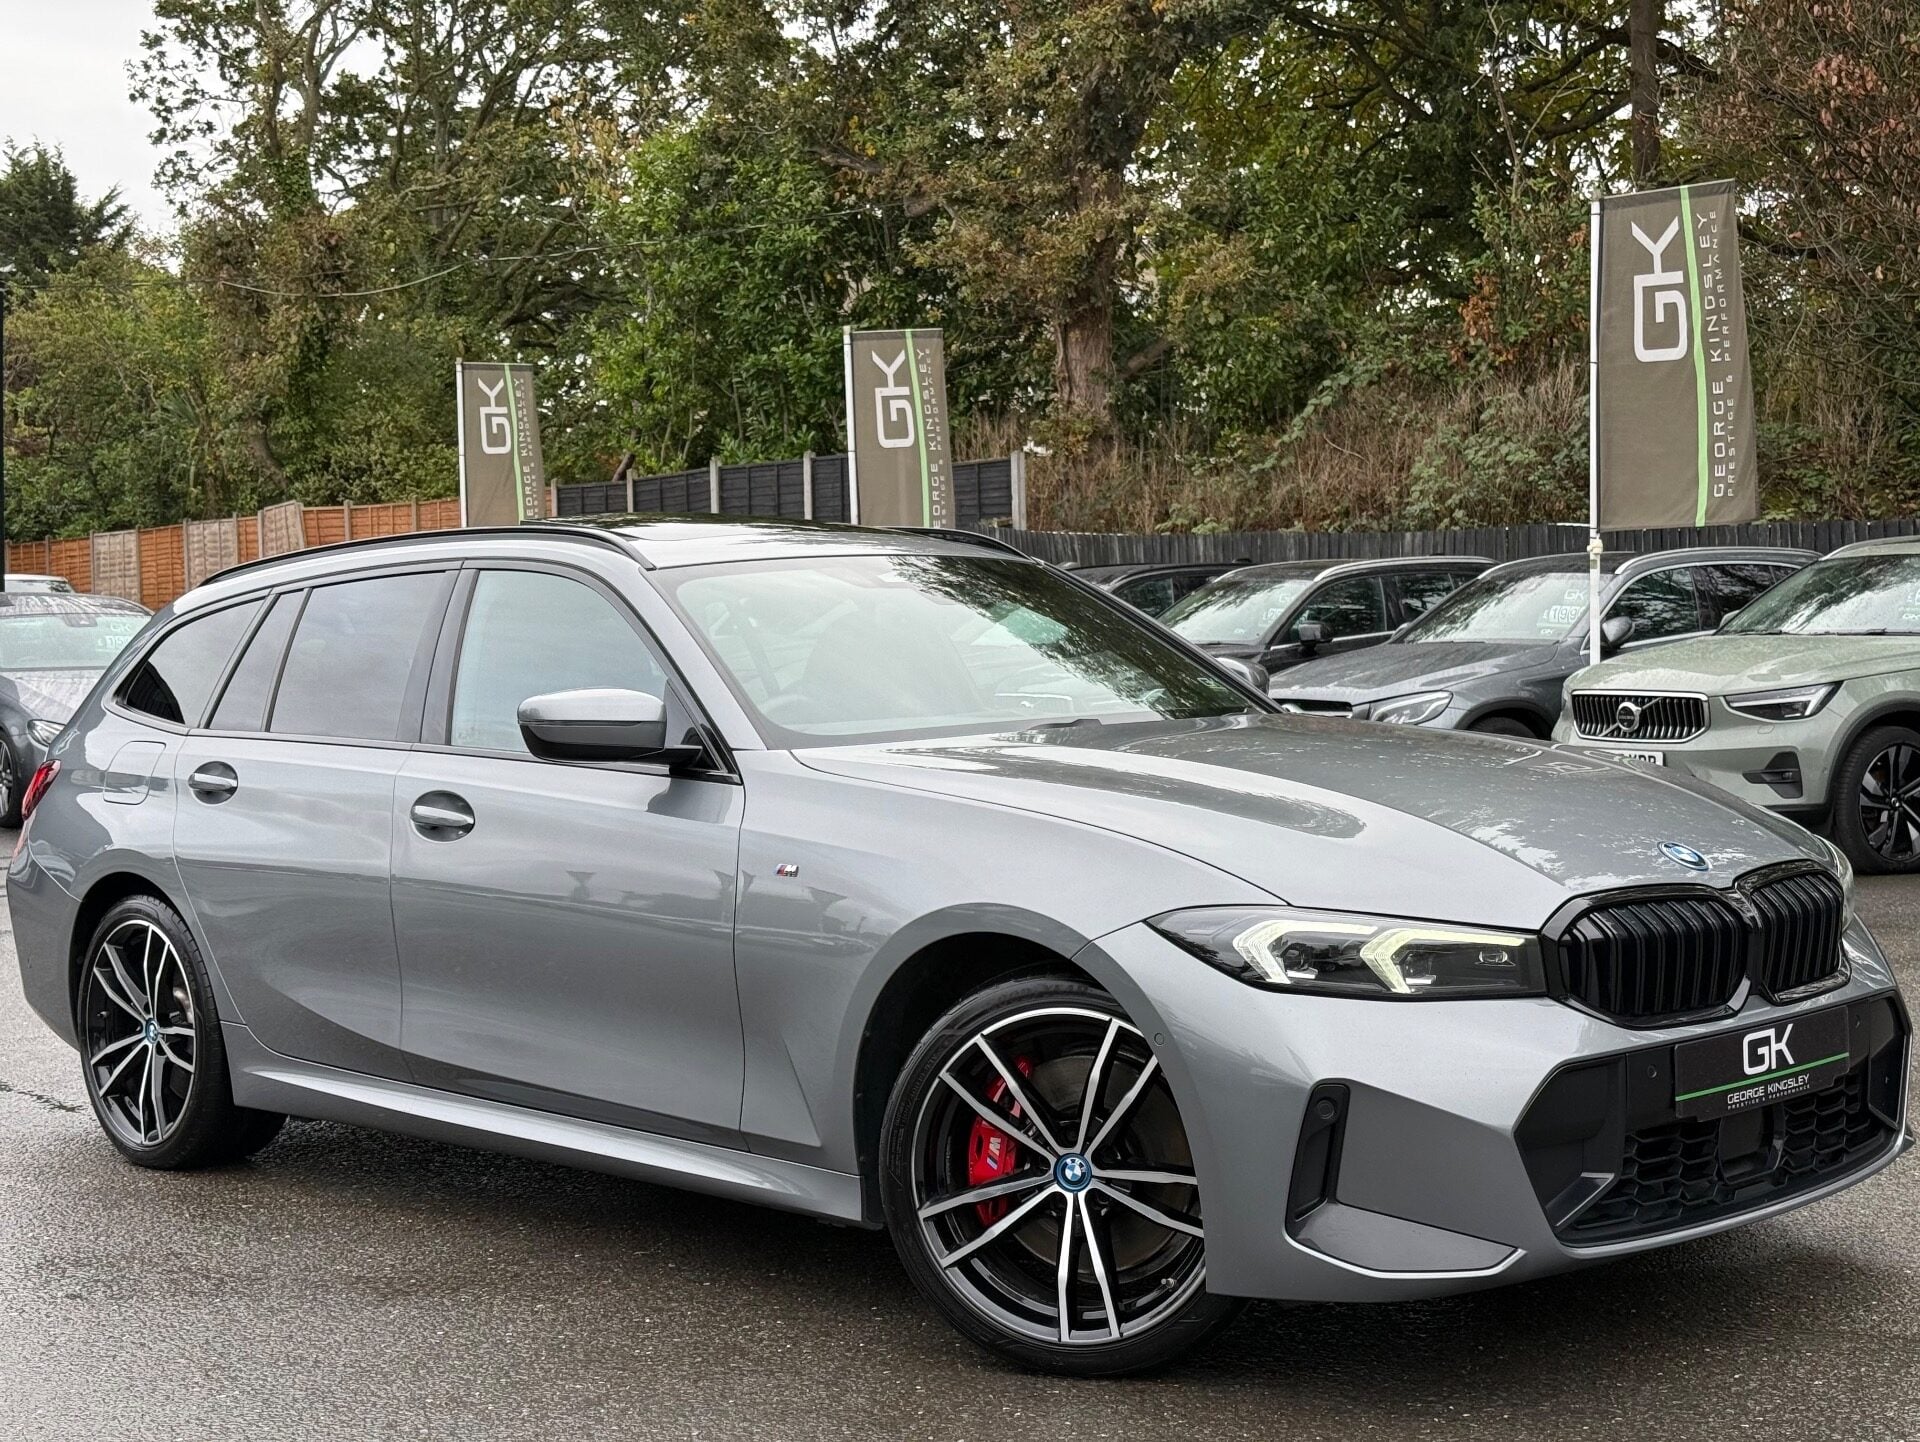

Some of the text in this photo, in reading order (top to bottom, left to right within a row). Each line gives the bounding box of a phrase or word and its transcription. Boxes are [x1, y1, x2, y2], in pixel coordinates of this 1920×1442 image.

[1631, 216, 1688, 362] GK
[1709, 210, 1731, 361] PERFORMANCE
[872, 350, 915, 448] GK
[1696, 213, 1726, 497] GEORGE KINGSLEY
[478, 378, 511, 454] GK
[514, 378, 534, 516] EORGE KINGSLEY
[917, 349, 941, 529] EORGE KINGSLEY
[1726, 399, 1736, 497] PRESTIGE
[1542, 605, 1585, 623] £199
[1728, 1073, 1810, 1104] GEORGE KINGSLEY
[1742, 1023, 1795, 1075] GK
